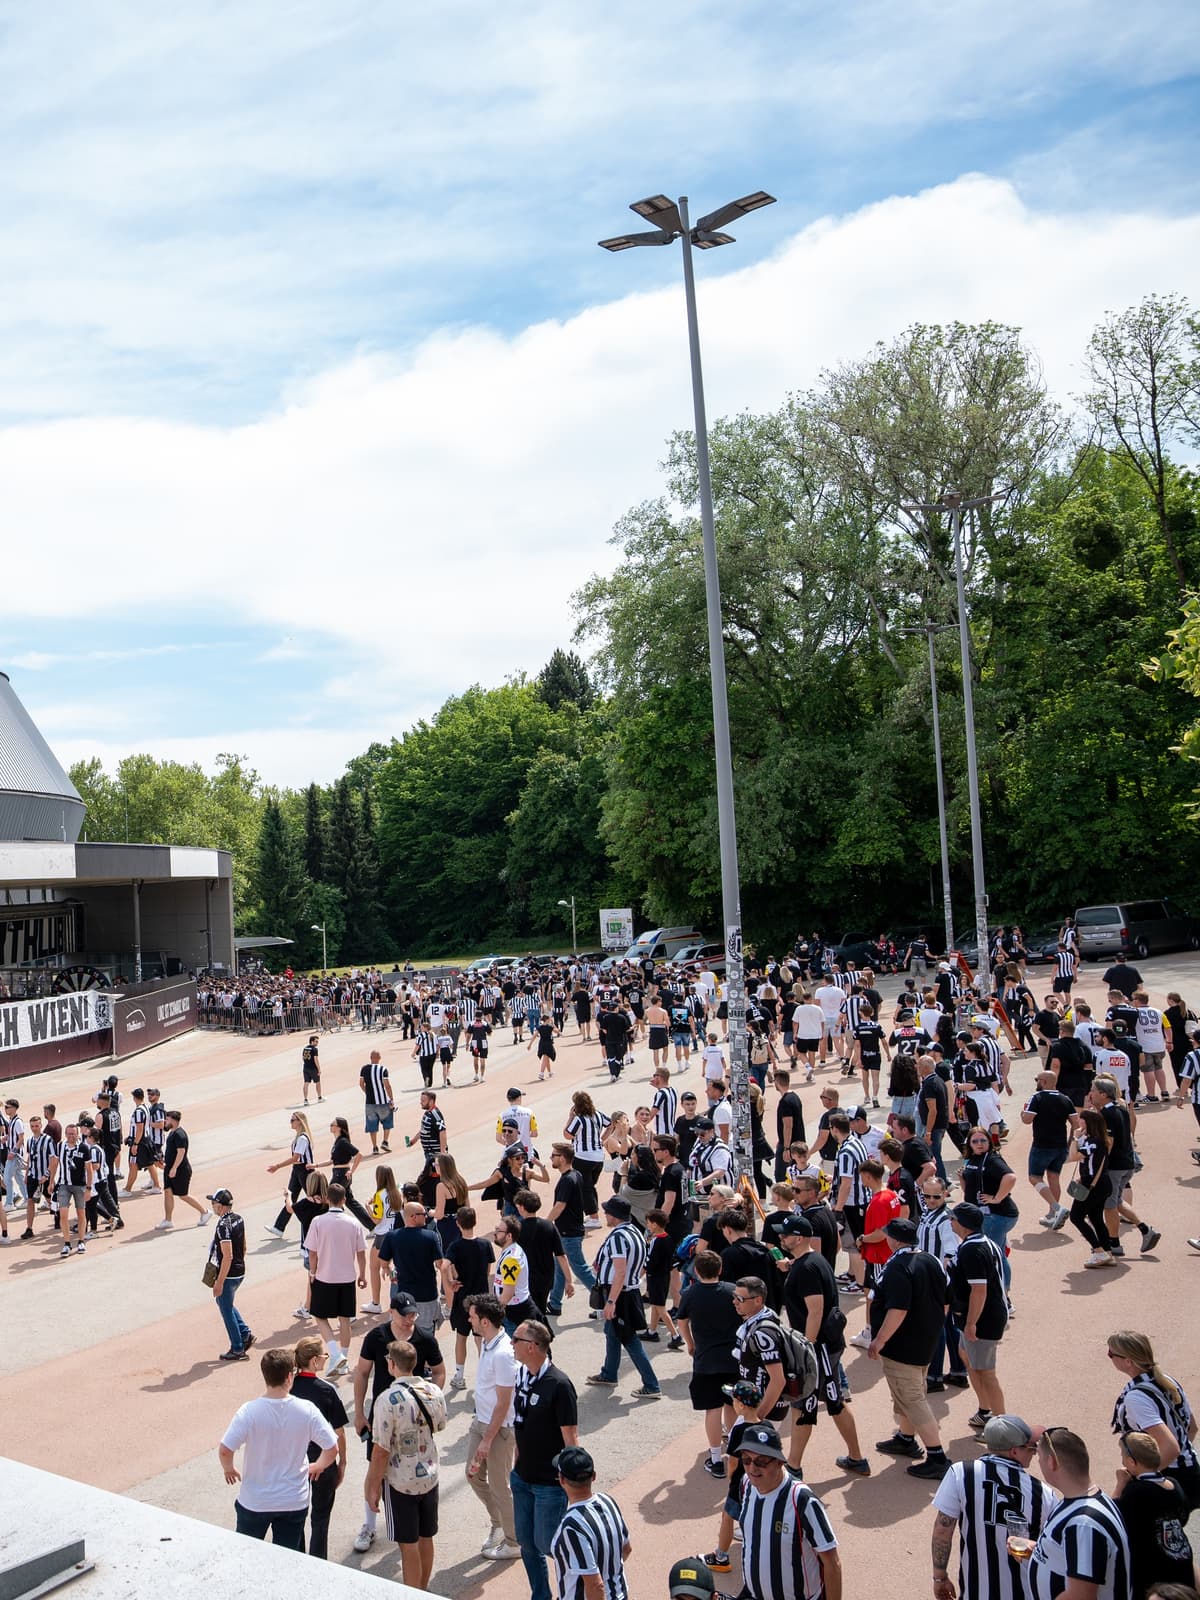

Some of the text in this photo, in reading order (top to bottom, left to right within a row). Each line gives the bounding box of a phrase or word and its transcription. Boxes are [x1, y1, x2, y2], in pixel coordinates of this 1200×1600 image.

[27, 992, 89, 1042] WIEN!
[431, 1005, 440, 1016] 12
[1138, 1009, 1160, 1026] 69
[901, 1039, 921, 1055] 27
[1110, 1057, 1126, 1067] AVE
[761, 1350, 780, 1361] IWT
[982, 1479, 1028, 1527] 12
[775, 1520, 789, 1534] 65
